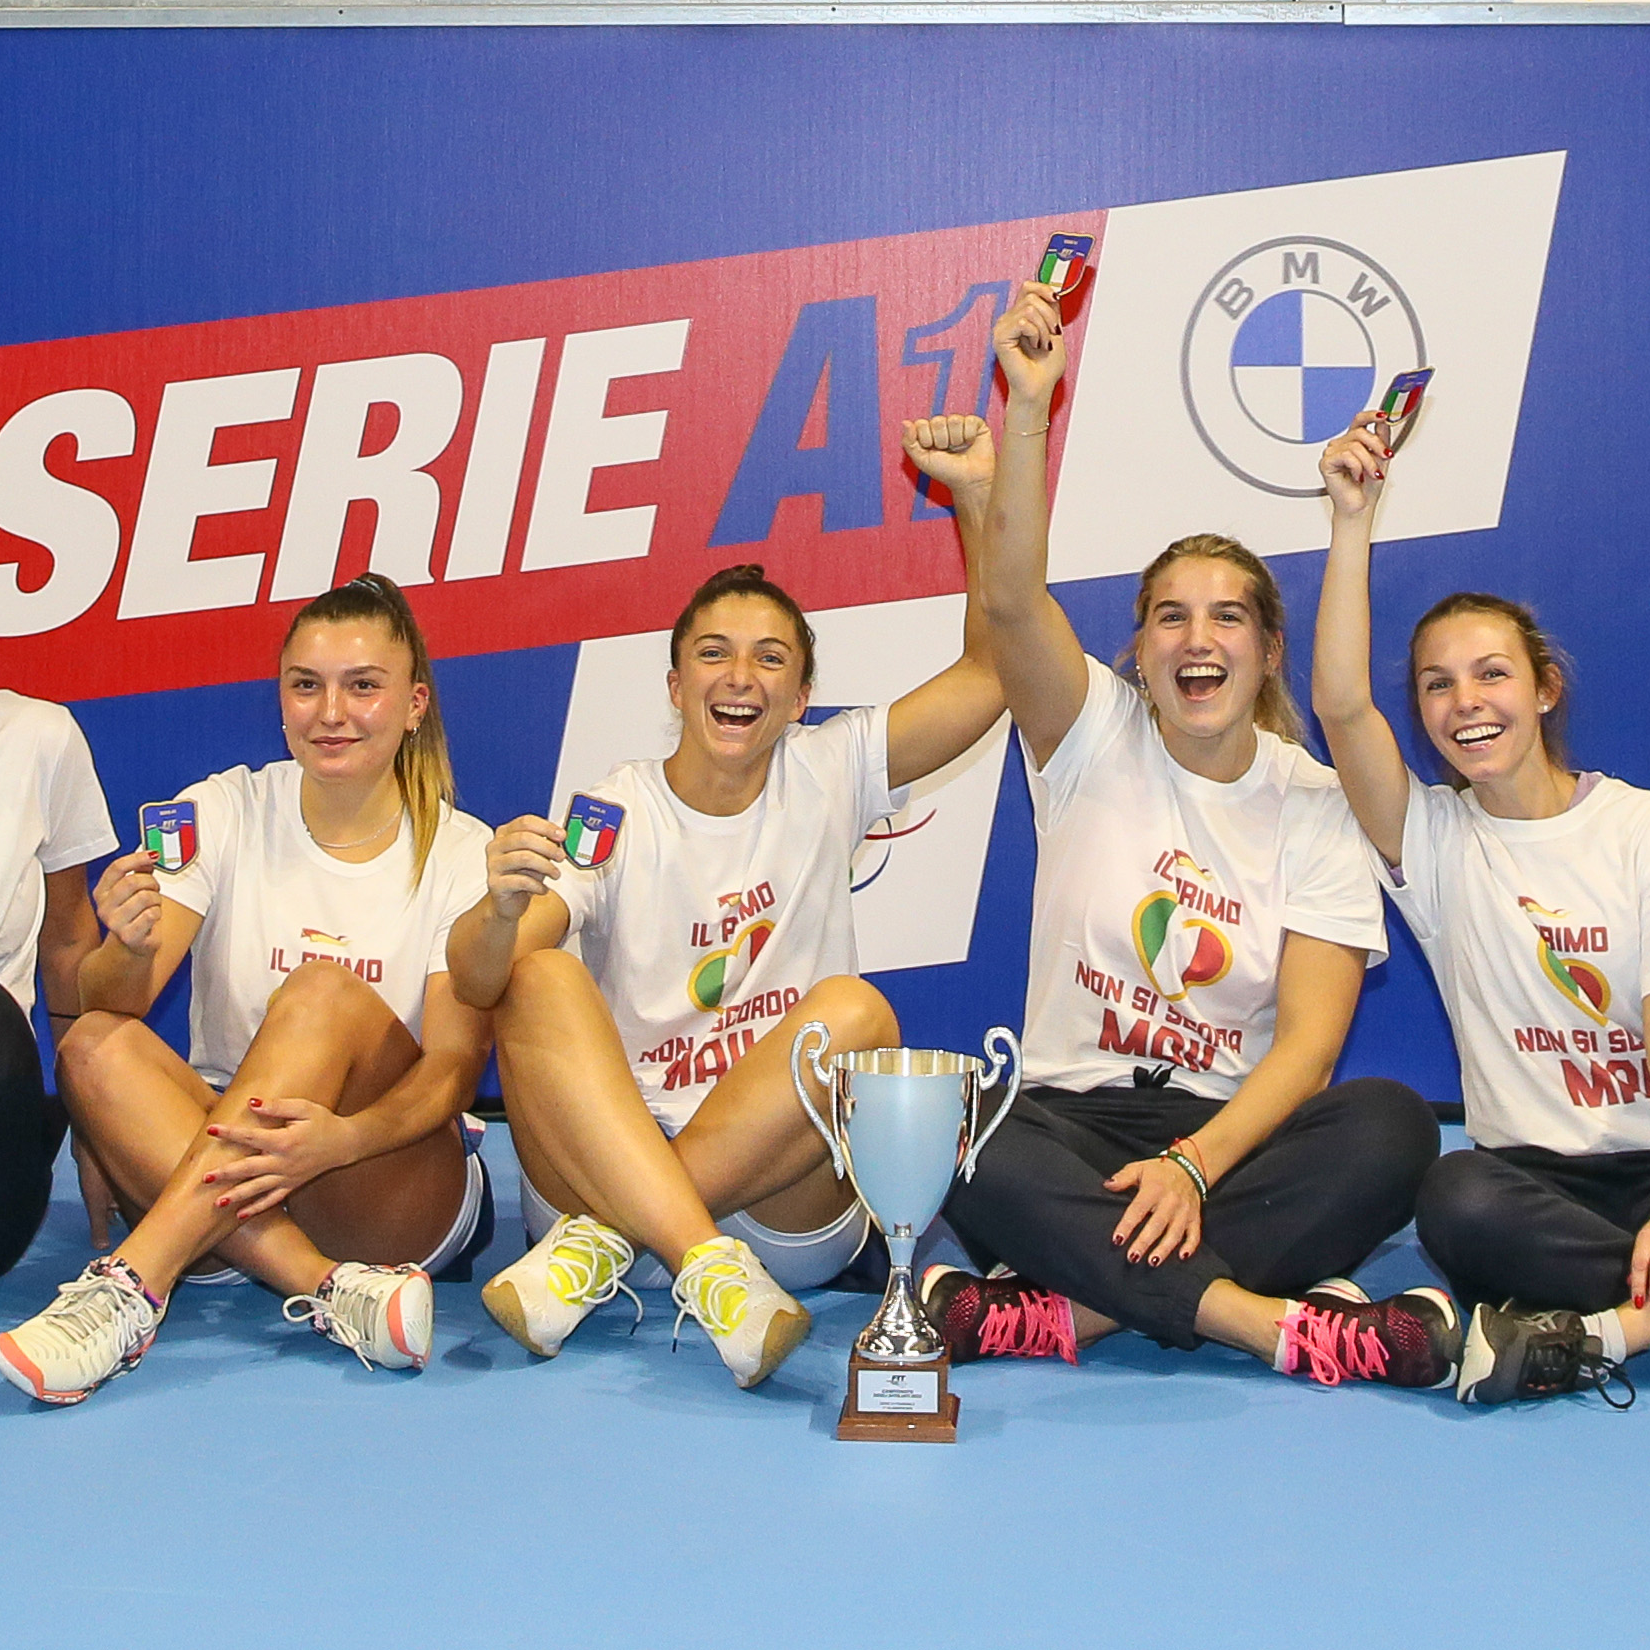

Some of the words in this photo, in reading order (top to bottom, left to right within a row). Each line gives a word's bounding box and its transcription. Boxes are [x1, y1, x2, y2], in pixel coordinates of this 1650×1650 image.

[1214, 252, 1392, 320] BMW
[1153, 850, 1176, 881] IL
[691, 922, 713, 947] IL
[270, 948, 291, 973] IL
[1075, 960, 1125, 1004] NON
[1132, 985, 1159, 1016] SI
[1515, 1027, 1568, 1053] NON
[1572, 1029, 1598, 1053] SI
